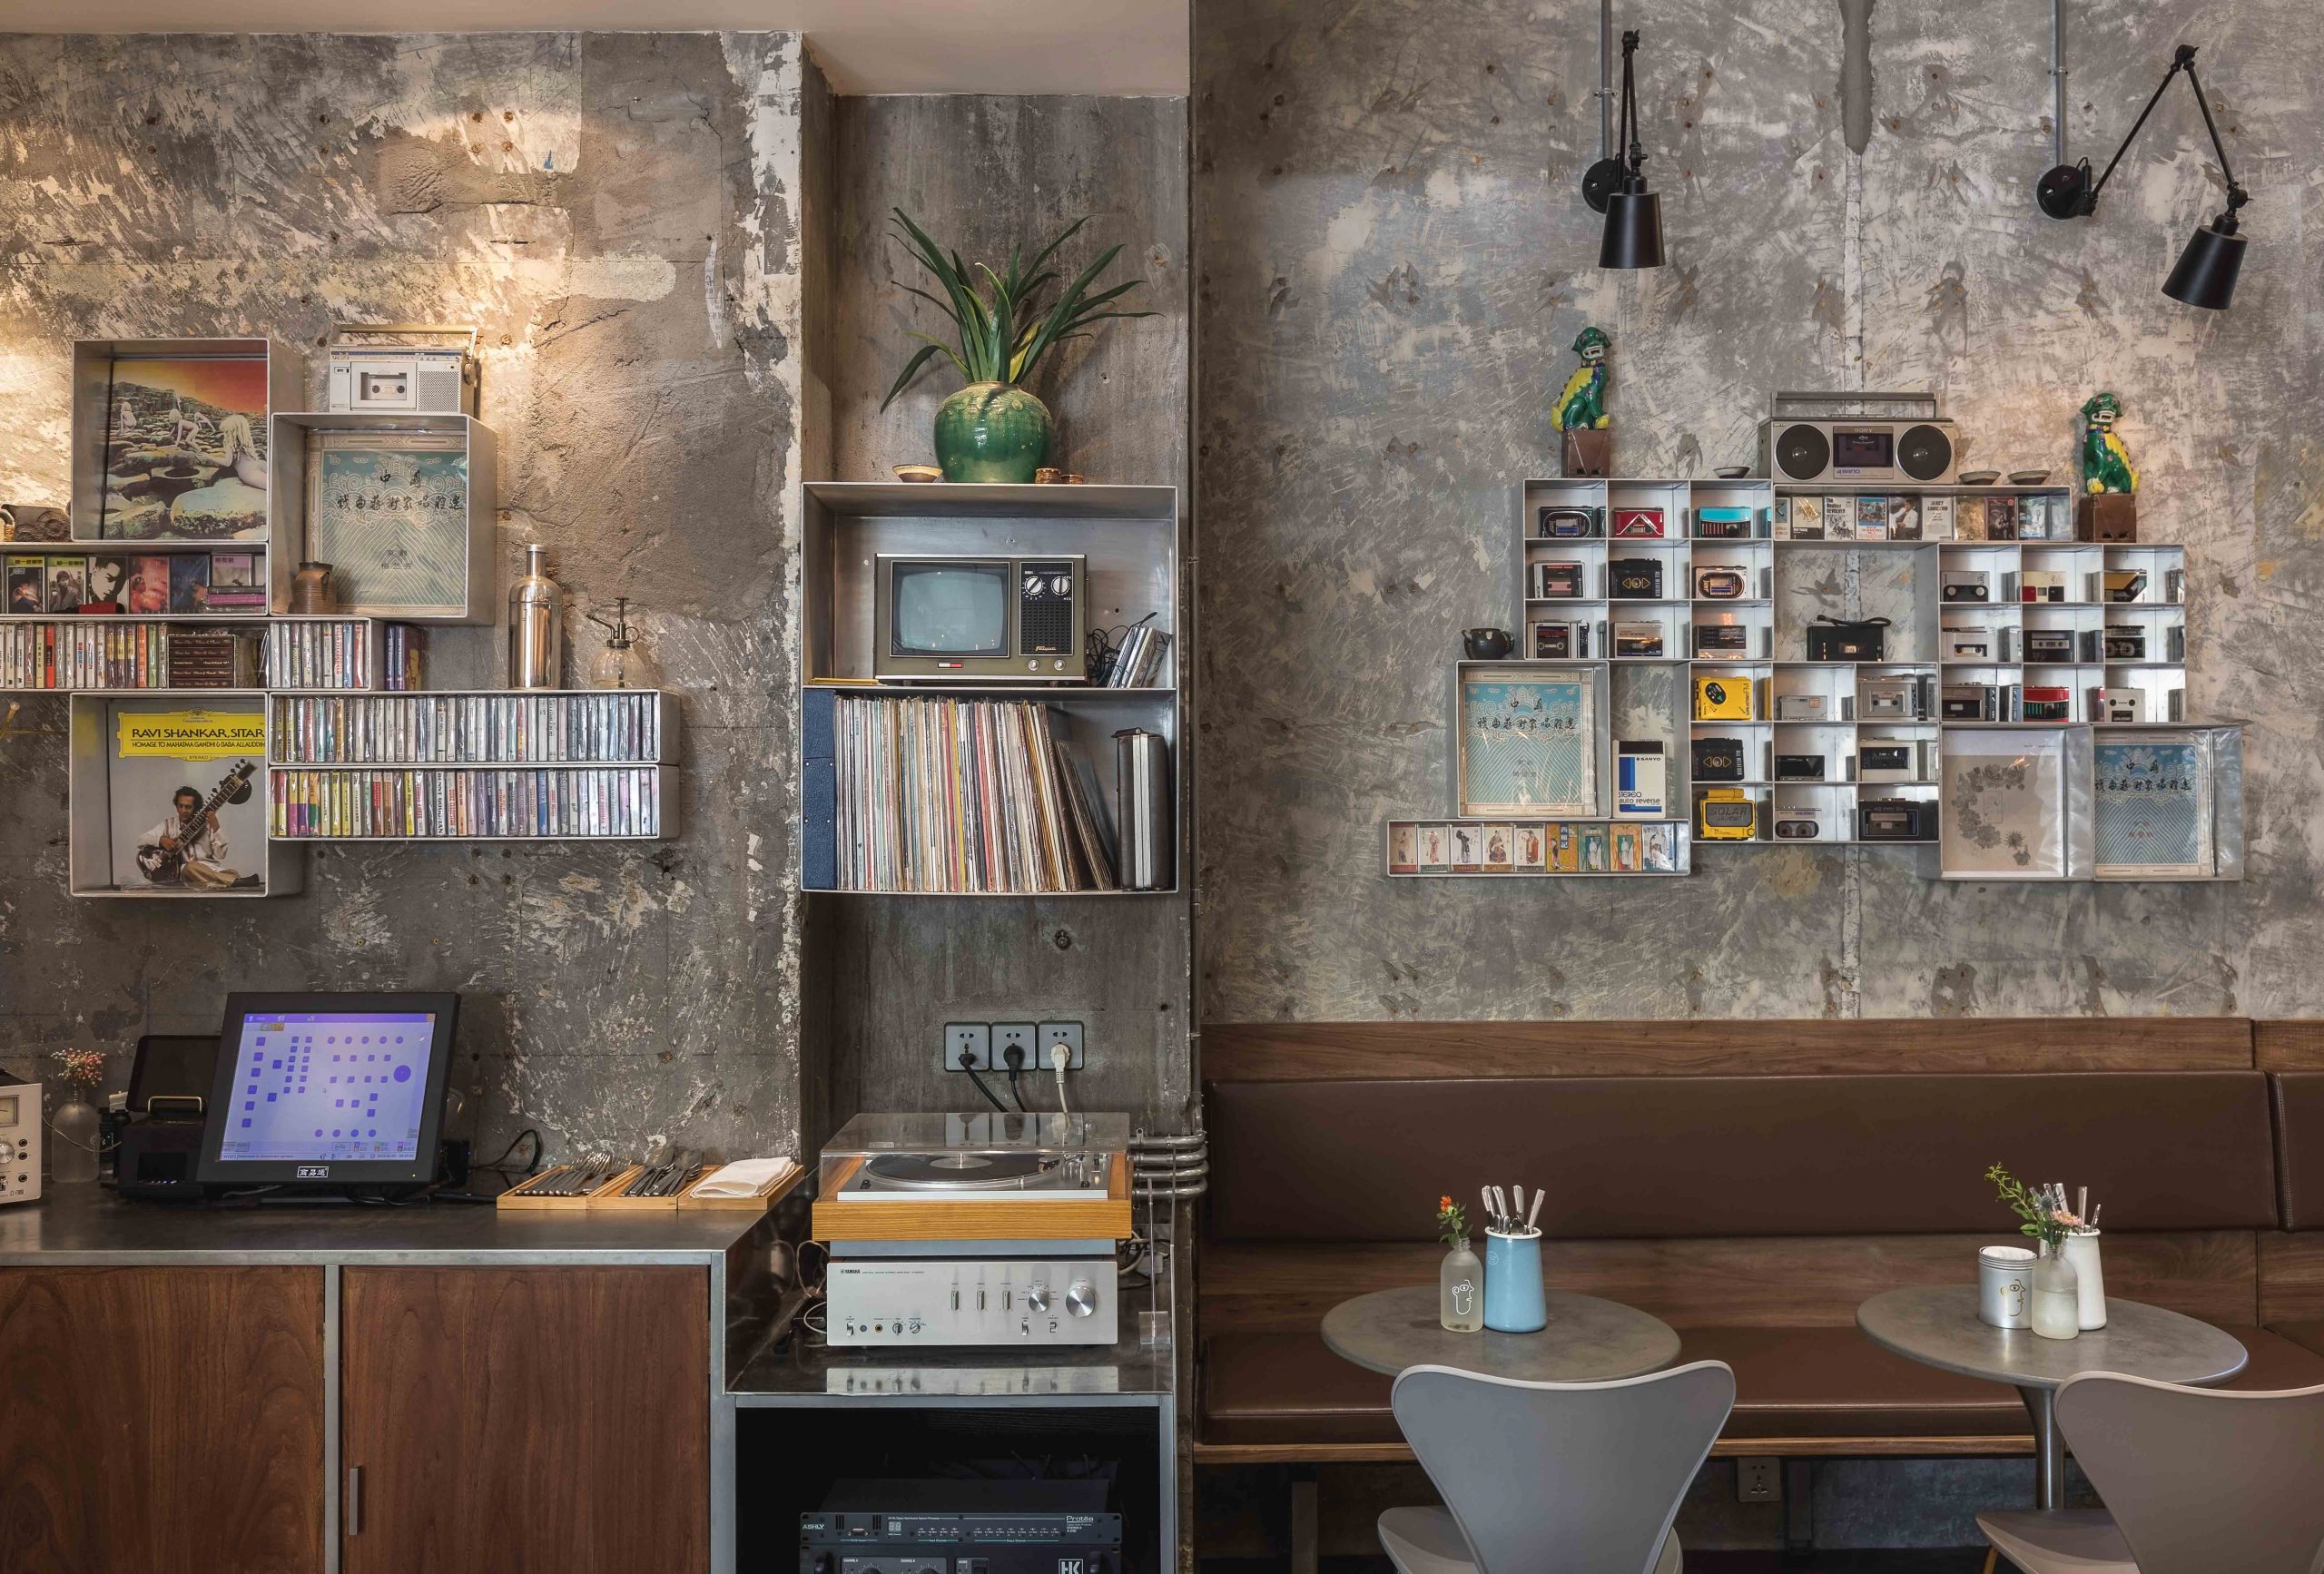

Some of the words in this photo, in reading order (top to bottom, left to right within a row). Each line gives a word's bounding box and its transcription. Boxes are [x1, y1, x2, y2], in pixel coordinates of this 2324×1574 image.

[133, 728, 161, 738] RAVI
[164, 728, 229, 738] SHANKAR,
[231, 728, 265, 738] SITAR
[1713, 807, 1747, 815] SOLAR
[1061, 1561, 1081, 1574] HK
